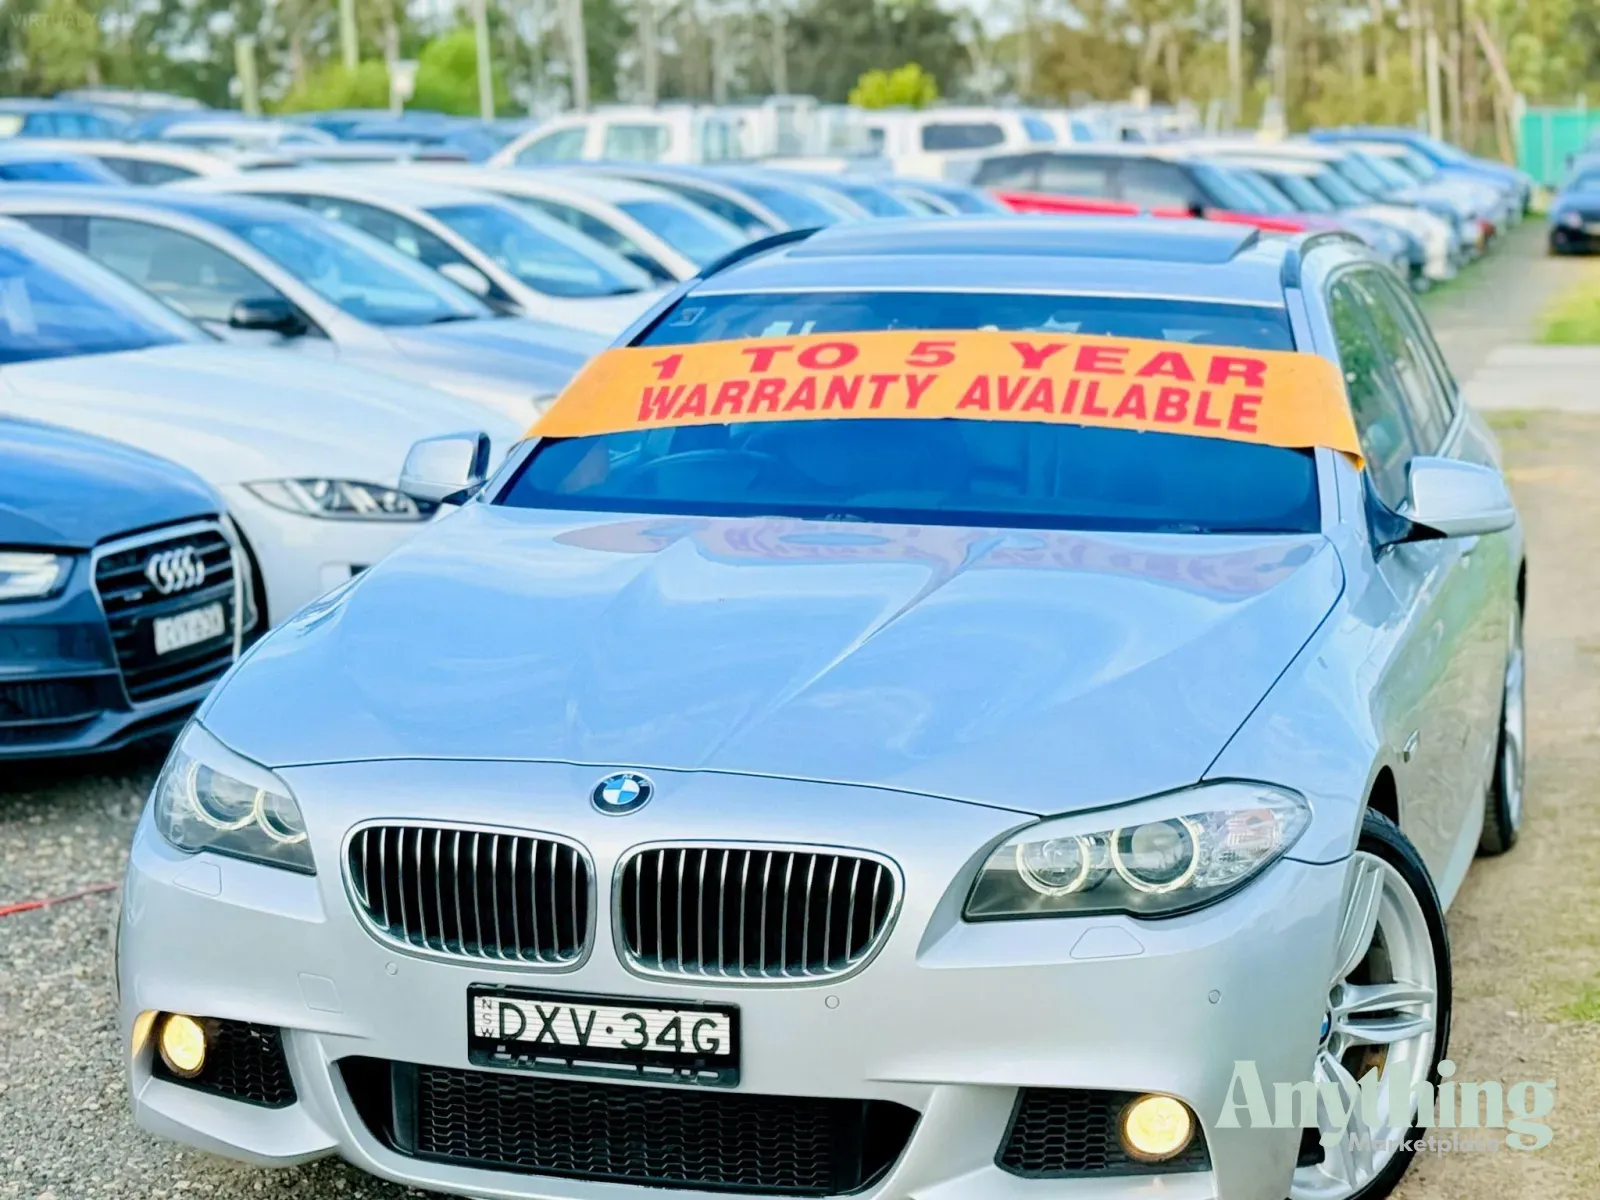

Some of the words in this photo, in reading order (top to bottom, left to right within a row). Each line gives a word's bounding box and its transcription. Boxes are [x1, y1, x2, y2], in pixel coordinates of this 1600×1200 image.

[652, 354, 684, 380] 1
[742, 342, 860, 373] TO
[905, 341, 956, 367] 5
[1010, 342, 1268, 388] YEAR
[637, 374, 939, 421] WARRANTY
[956, 375, 1264, 433] AVAILABLE
